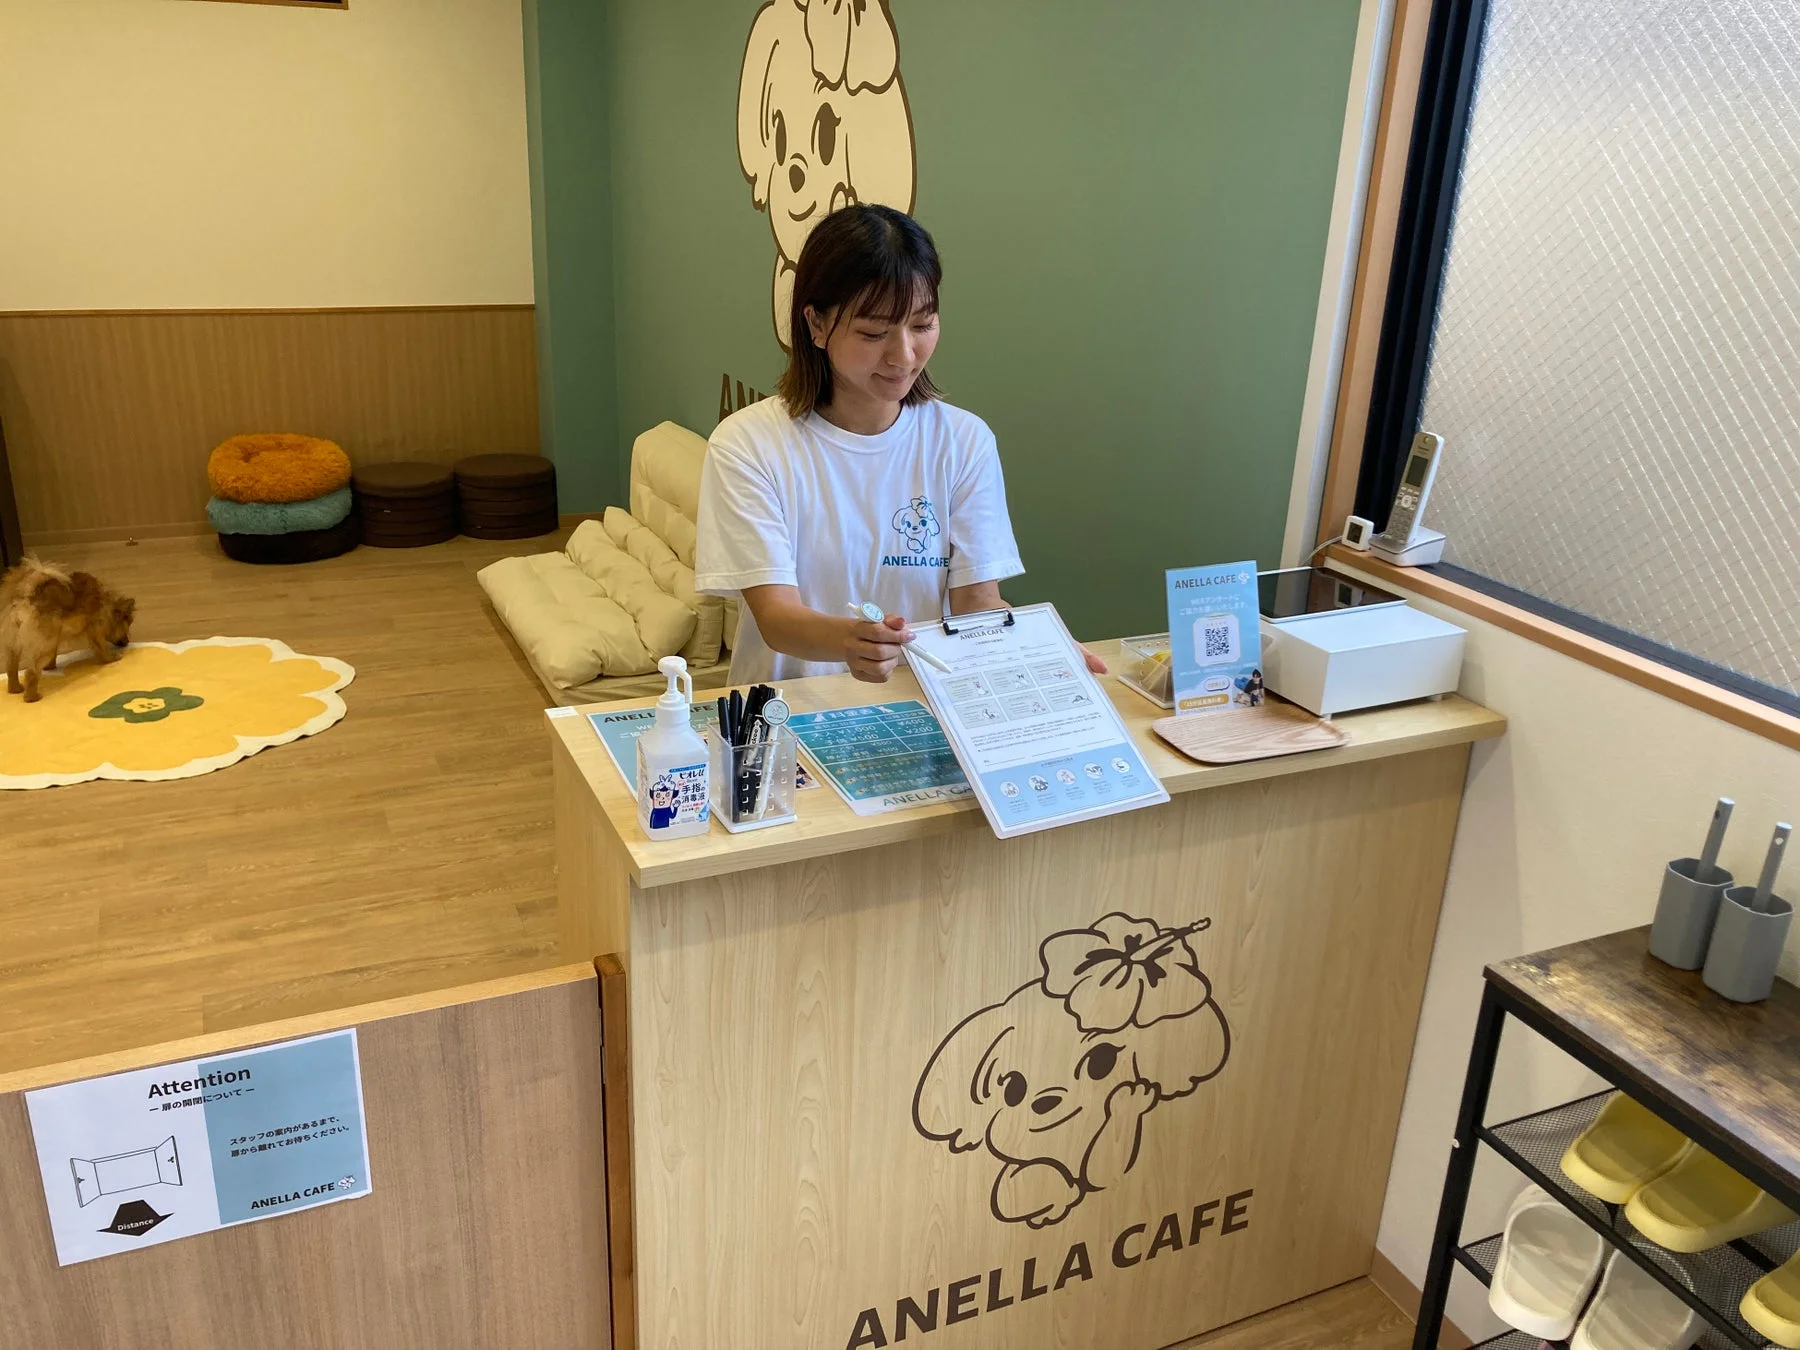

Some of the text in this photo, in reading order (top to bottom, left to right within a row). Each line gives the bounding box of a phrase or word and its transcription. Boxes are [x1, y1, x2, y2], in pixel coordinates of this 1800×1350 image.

[883, 556, 949, 568] ANELLA CAFE
[1175, 574, 1237, 589] ANELLA CAFE
[960, 628, 1004, 641] ANELLA CAFE
[904, 726, 934, 734] ¥200
[681, 783, 705, 795] 手指の
[682, 792, 705, 804] 消毒液
[883, 788, 947, 806] ANELLA
[148, 1068, 251, 1099] Attention
[230, 1116, 340, 1146] スタッフの案内があるまで、
[231, 1125, 349, 1157] 扉から離れてお待ちください。
[250, 1182, 335, 1210] ANELLA CAFE
[117, 1219, 154, 1231] Distance
[847, 1189, 1254, 1350] ANELLA CAFE
